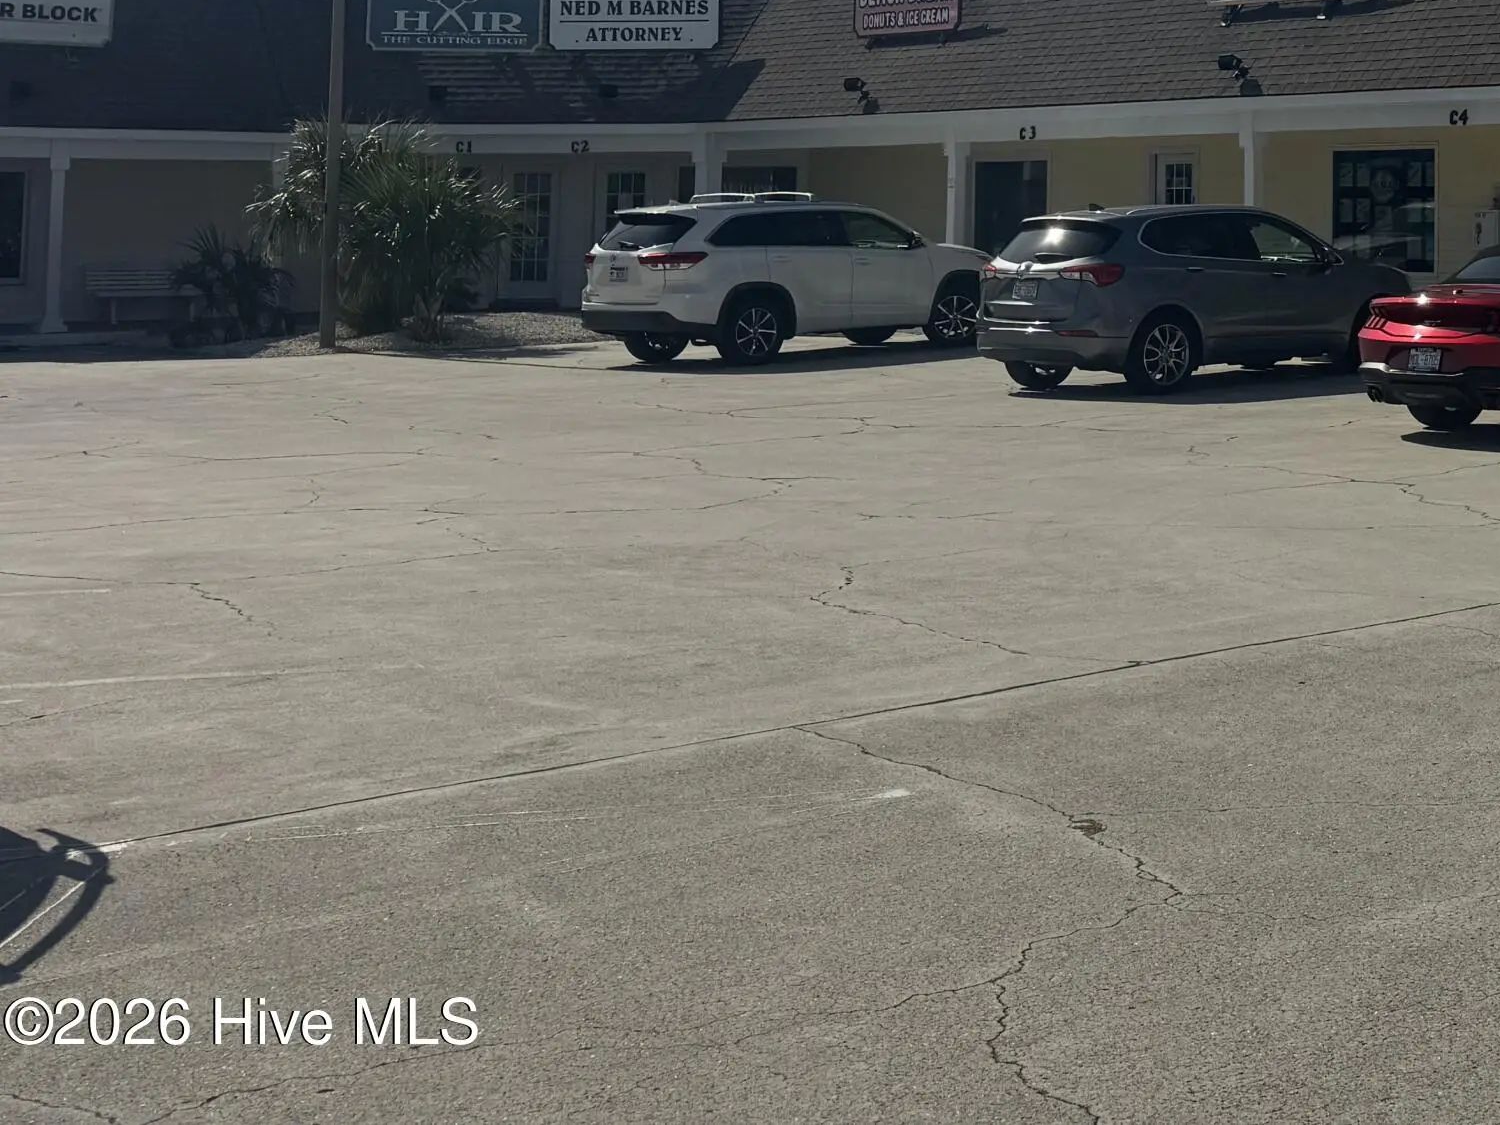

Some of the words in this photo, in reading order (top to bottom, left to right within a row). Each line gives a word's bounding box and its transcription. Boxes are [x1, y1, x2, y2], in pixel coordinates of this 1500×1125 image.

[22, 3, 97, 22] BLOCK
[560, 0, 600, 16] NED
[607, 0, 623, 16] M
[629, 0, 709, 16] BARNES
[863, 10, 896, 30] DONUTS
[897, 10, 905, 27] &
[906, 9, 919, 26] ICE
[920, 7, 950, 25] CREAM
[381, 35, 410, 44] THE
[416, 35, 481, 45] CUTTING
[487, 37, 528, 45] EDGE
[586, 26, 683, 42] ATTORNEY
[1449, 108, 1469, 126] C4
[1019, 125, 1037, 140] C3
[455, 140, 473, 153] C1
[570, 139, 590, 153] C2
